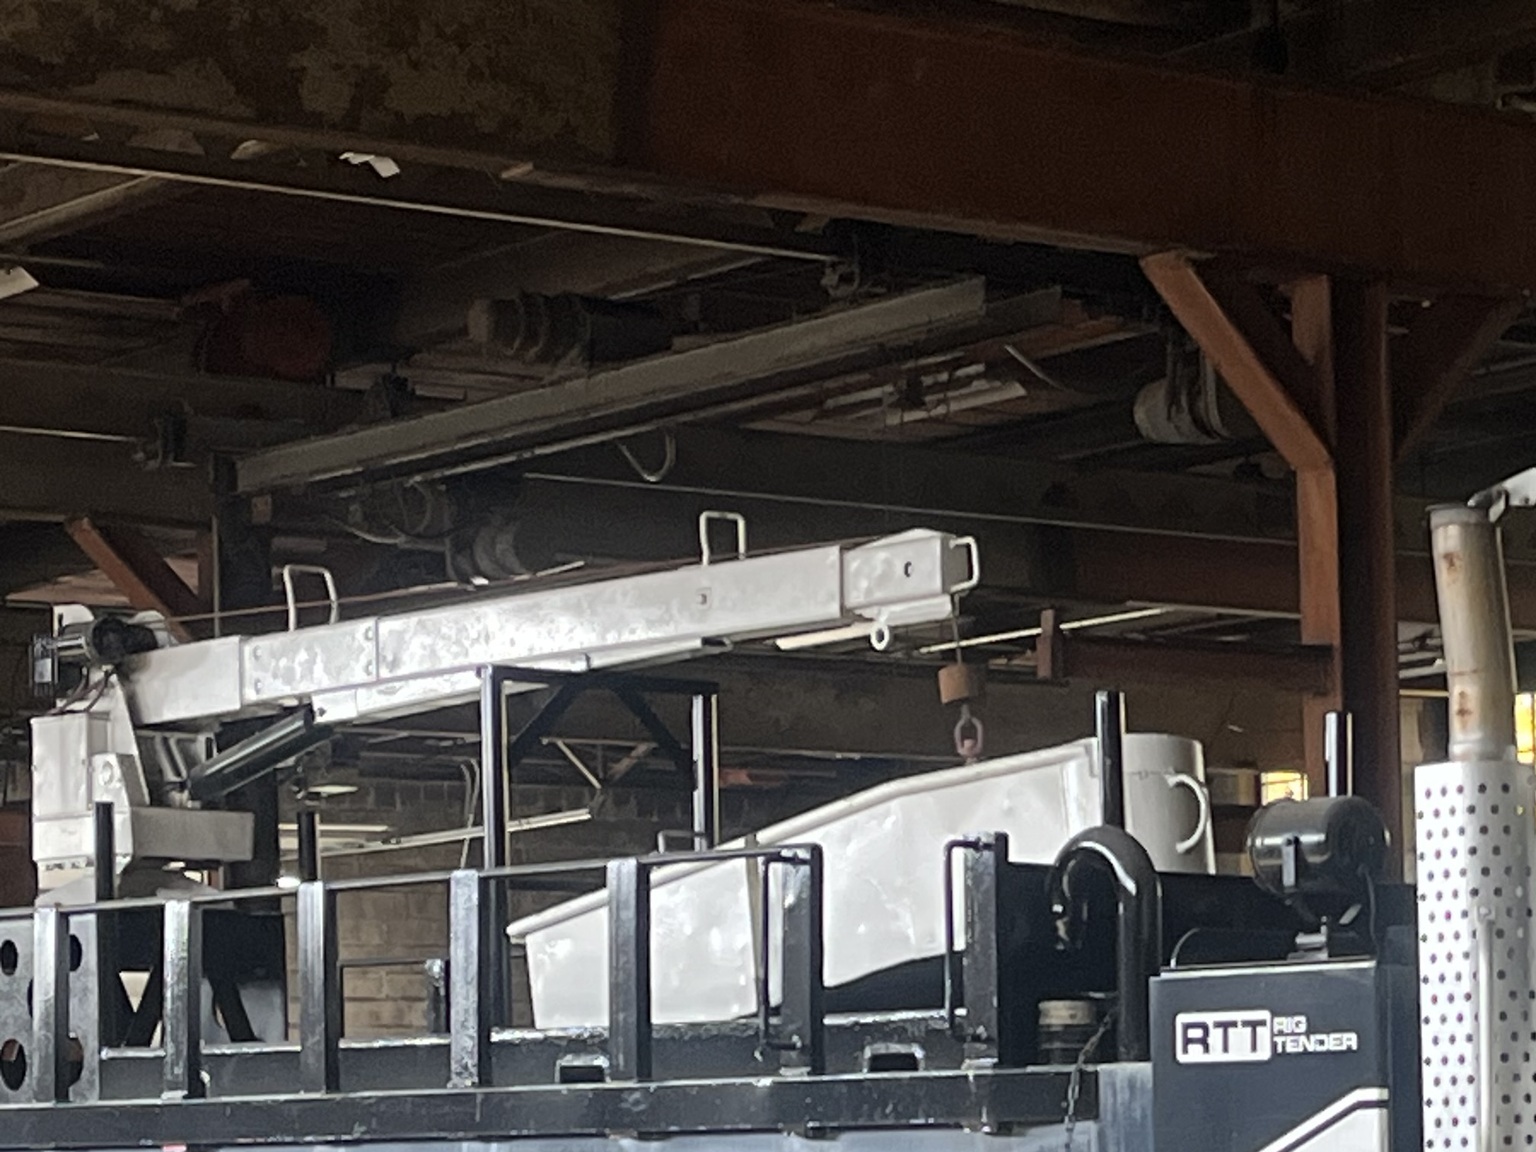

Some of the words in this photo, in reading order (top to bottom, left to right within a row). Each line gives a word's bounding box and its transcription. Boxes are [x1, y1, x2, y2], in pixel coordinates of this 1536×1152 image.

[1273, 1016, 1307, 1034] RIG
[1182, 1020, 1267, 1055] RTT
[1274, 1032, 1358, 1054] TENDER
